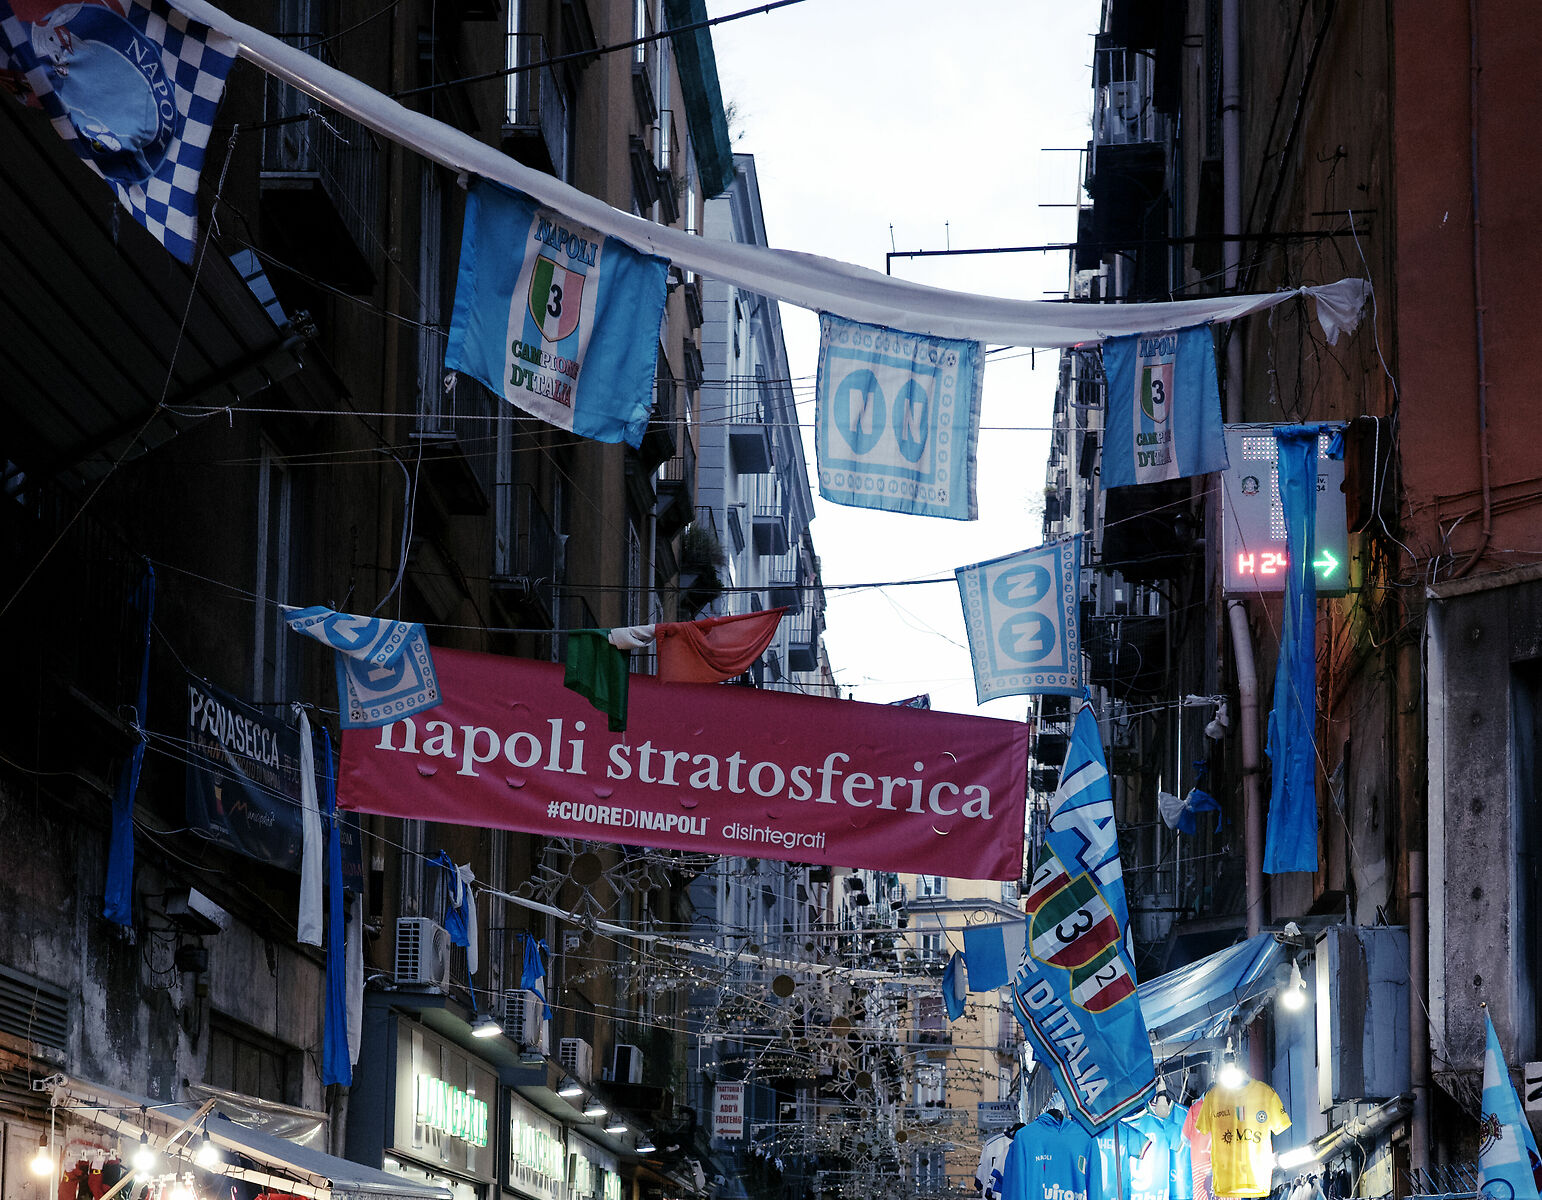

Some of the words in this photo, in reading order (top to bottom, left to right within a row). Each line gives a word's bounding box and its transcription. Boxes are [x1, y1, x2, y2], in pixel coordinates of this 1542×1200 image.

[126, 38, 174, 150] NAPOLI
[534, 218, 599, 267] NAPOLI
[547, 284, 563, 318] 3
[1151, 379, 1165, 405] 3
[374, 715, 588, 778] napoli
[606, 739, 995, 821] stratosferica
[546, 800, 708, 837] #CUOREDINAPOLI
[722, 821, 826, 850] disintegrati
[1055, 909, 1094, 944] 3
[1095, 964, 1117, 988] 2
[1022, 977, 1109, 1107] D'ITALIA
